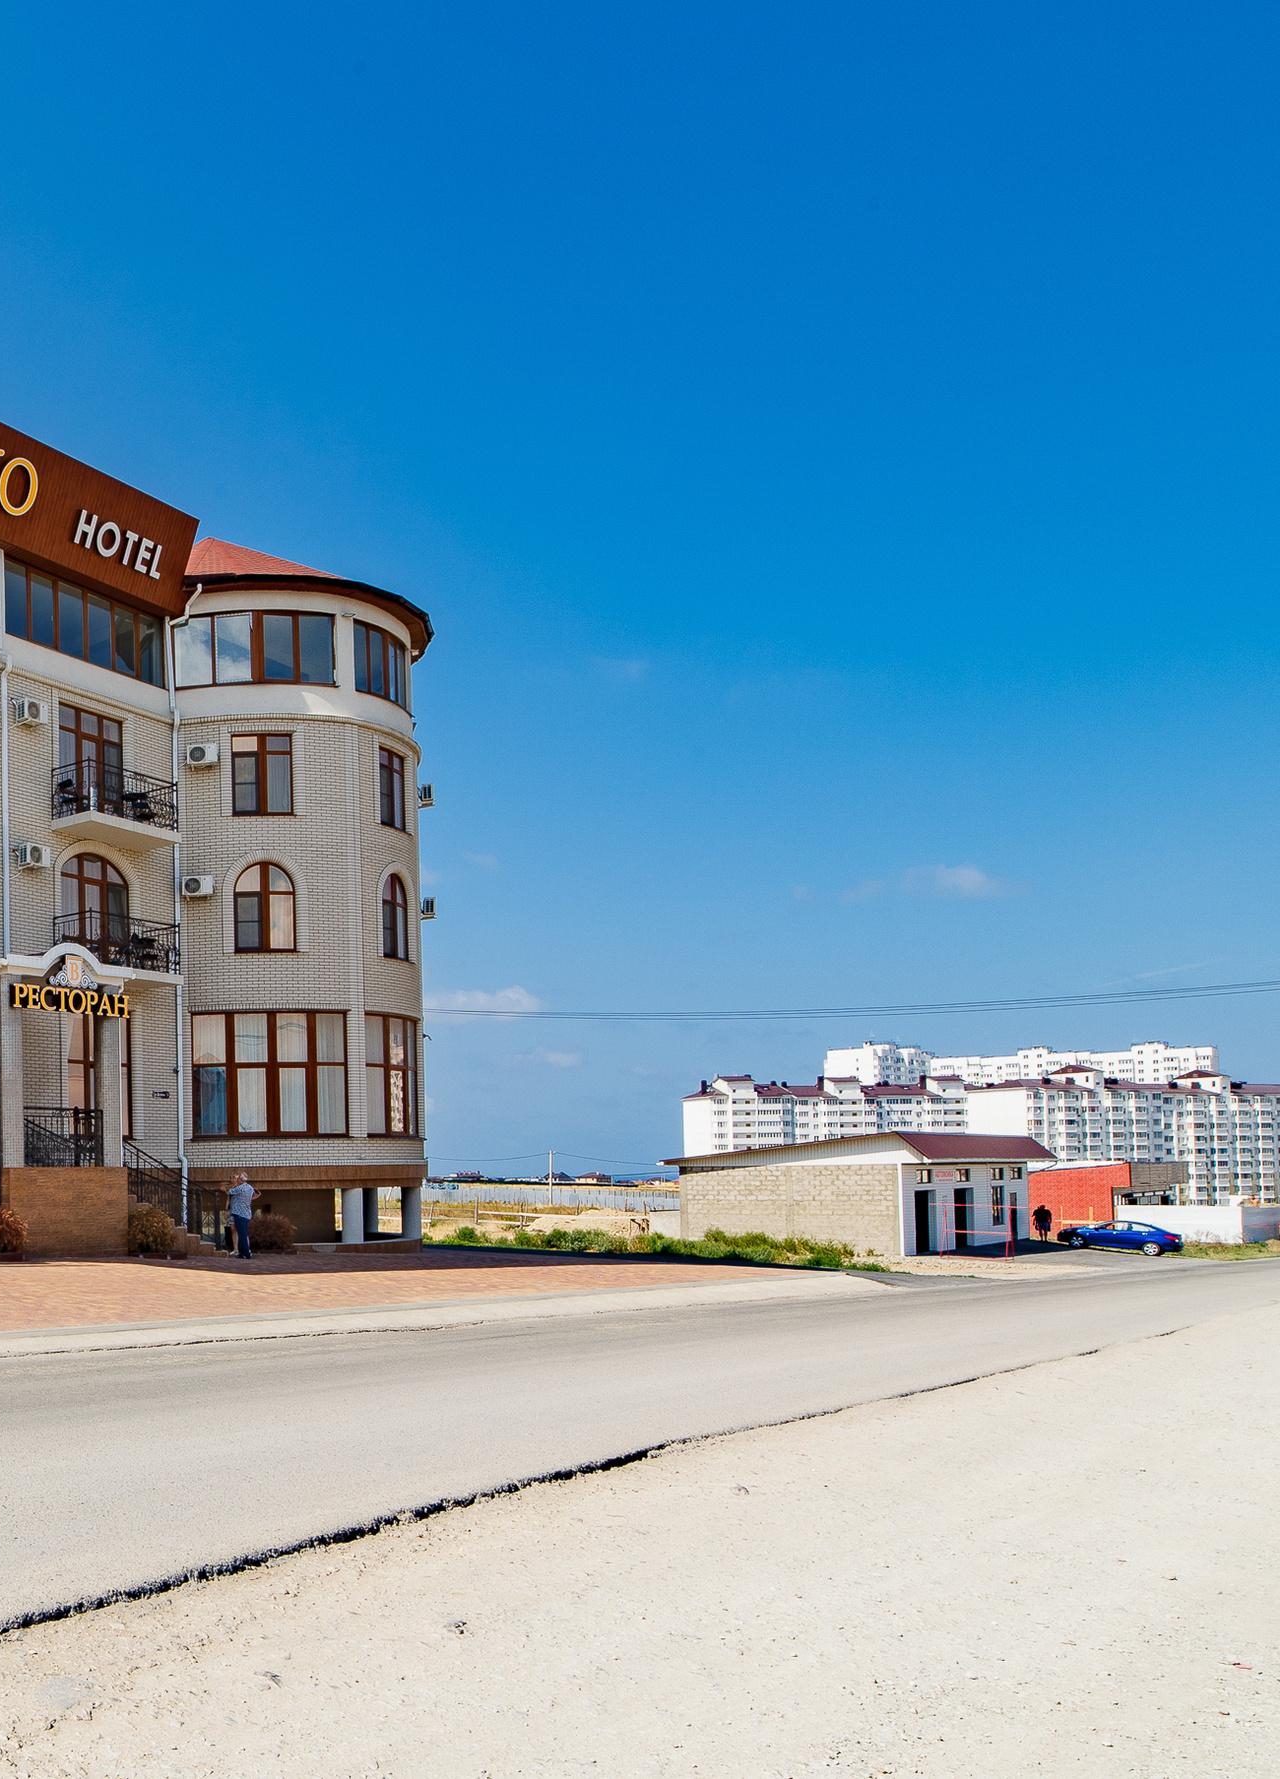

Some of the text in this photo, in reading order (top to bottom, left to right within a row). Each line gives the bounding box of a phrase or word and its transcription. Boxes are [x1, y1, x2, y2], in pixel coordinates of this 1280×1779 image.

[73, 508, 163, 580] HOTEL
[69, 961, 81, 982] B
[13, 983, 130, 1018] РЕСТОРАН
